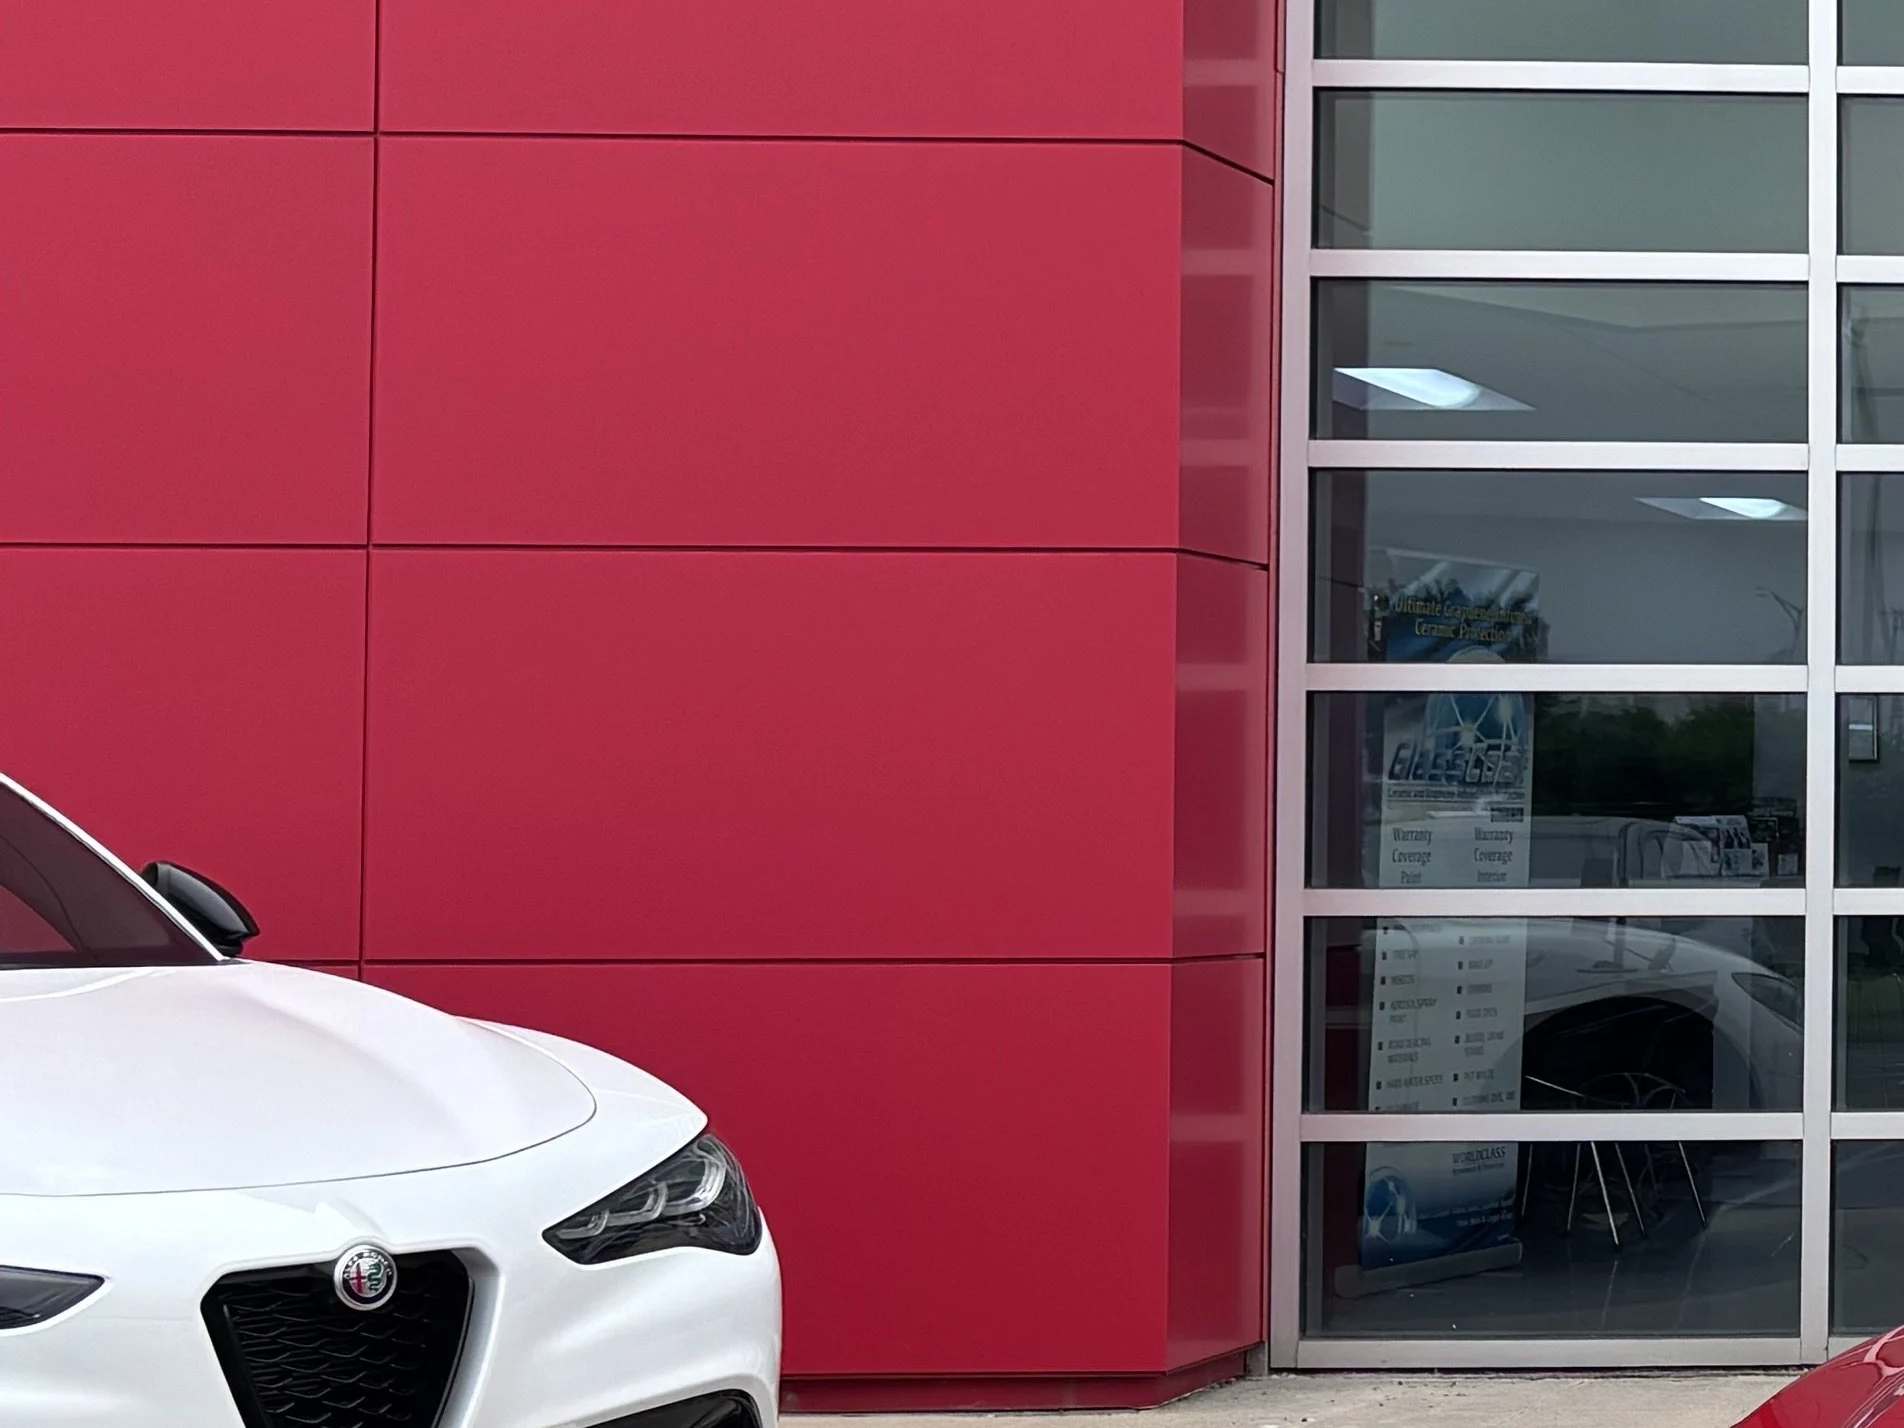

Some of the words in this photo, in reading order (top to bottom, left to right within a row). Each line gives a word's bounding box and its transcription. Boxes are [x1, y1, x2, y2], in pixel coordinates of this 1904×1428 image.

[1392, 827, 1433, 845] Warranty
[1474, 827, 1513, 845] Warranty
[1392, 848, 1432, 866] Coverage
[1473, 848, 1513, 865] Coverage
